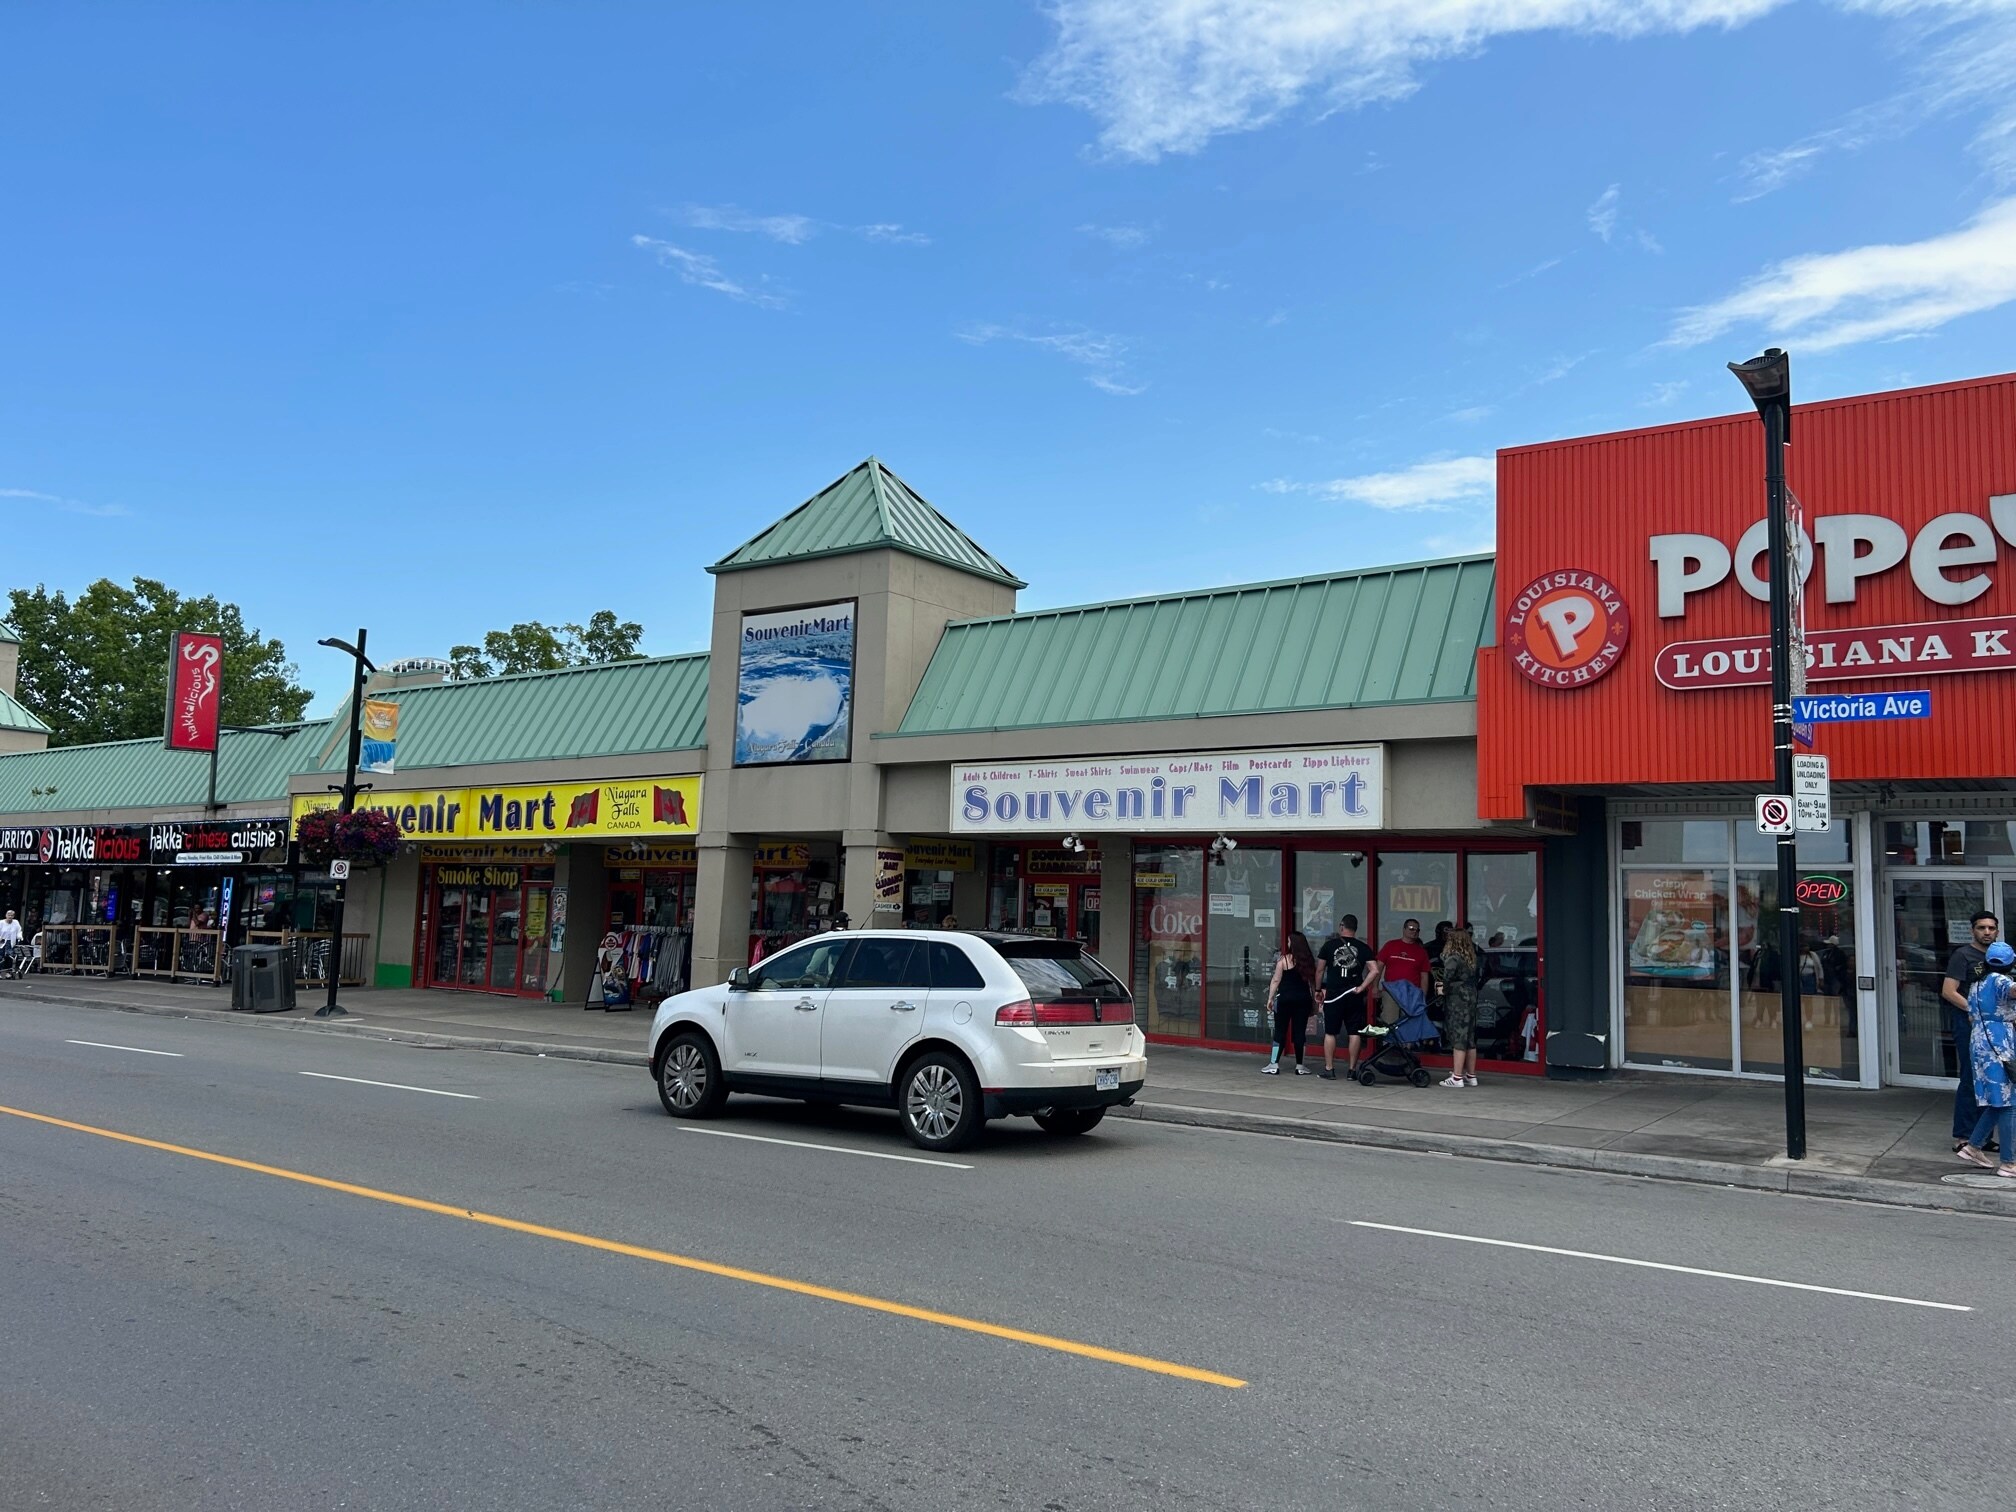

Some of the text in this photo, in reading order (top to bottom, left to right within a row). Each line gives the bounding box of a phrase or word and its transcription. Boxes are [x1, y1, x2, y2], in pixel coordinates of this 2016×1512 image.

[1510, 573, 1620, 626] LOUISIANA
[744, 614, 850, 643] Souvenir Mart
[1536, 596, 1595, 658] P
[1515, 641, 1619, 685] KITCHEN
[1673, 635, 1952, 678] LOUIANA
[181, 667, 201, 742] hakkalicious
[1800, 696, 1923, 719] Victoria Ave
[963, 772, 981, 782] Adult
[990, 770, 1021, 780] Childrens
[1028, 768, 1058, 779] T-Shirts
[1065, 767, 1088, 777] Sweat
[1090, 766, 1112, 776] Shirts
[1119, 763, 1160, 775] Swimwear
[1168, 762, 1213, 774] Caps/Hats
[1222, 760, 1240, 771] Film
[1249, 758, 1292, 770] Postcards
[1303, 756, 1329, 769] Zippo
[1331, 755, 1371, 768] Lighters
[1797, 761, 1820, 769] LOADING
[1797, 771, 1826, 779] UNLOADING
[605, 787, 647, 804] Niagara
[962, 771, 1368, 824] Souvenir Mart
[479, 791, 555, 832] Mart
[611, 803, 640, 820] Falls
[231, 823, 276, 848] cuisine
[606, 821, 642, 829] CANADA
[0, 829, 33, 849] URRITO
[422, 845, 498, 857] Souvenir
[606, 844, 794, 861] Souven art
[906, 844, 973, 858] ouvenir Mart
[437, 866, 519, 889] Smoke Shop
[1653, 880, 1687, 890] Crispy
[1392, 887, 1440, 909] ATM
[1634, 889, 1707, 902] Chicken Wrap
[1796, 884, 1842, 898] OPEN
[1086, 897, 1100, 909] OP
[1150, 904, 1203, 934] Coke
